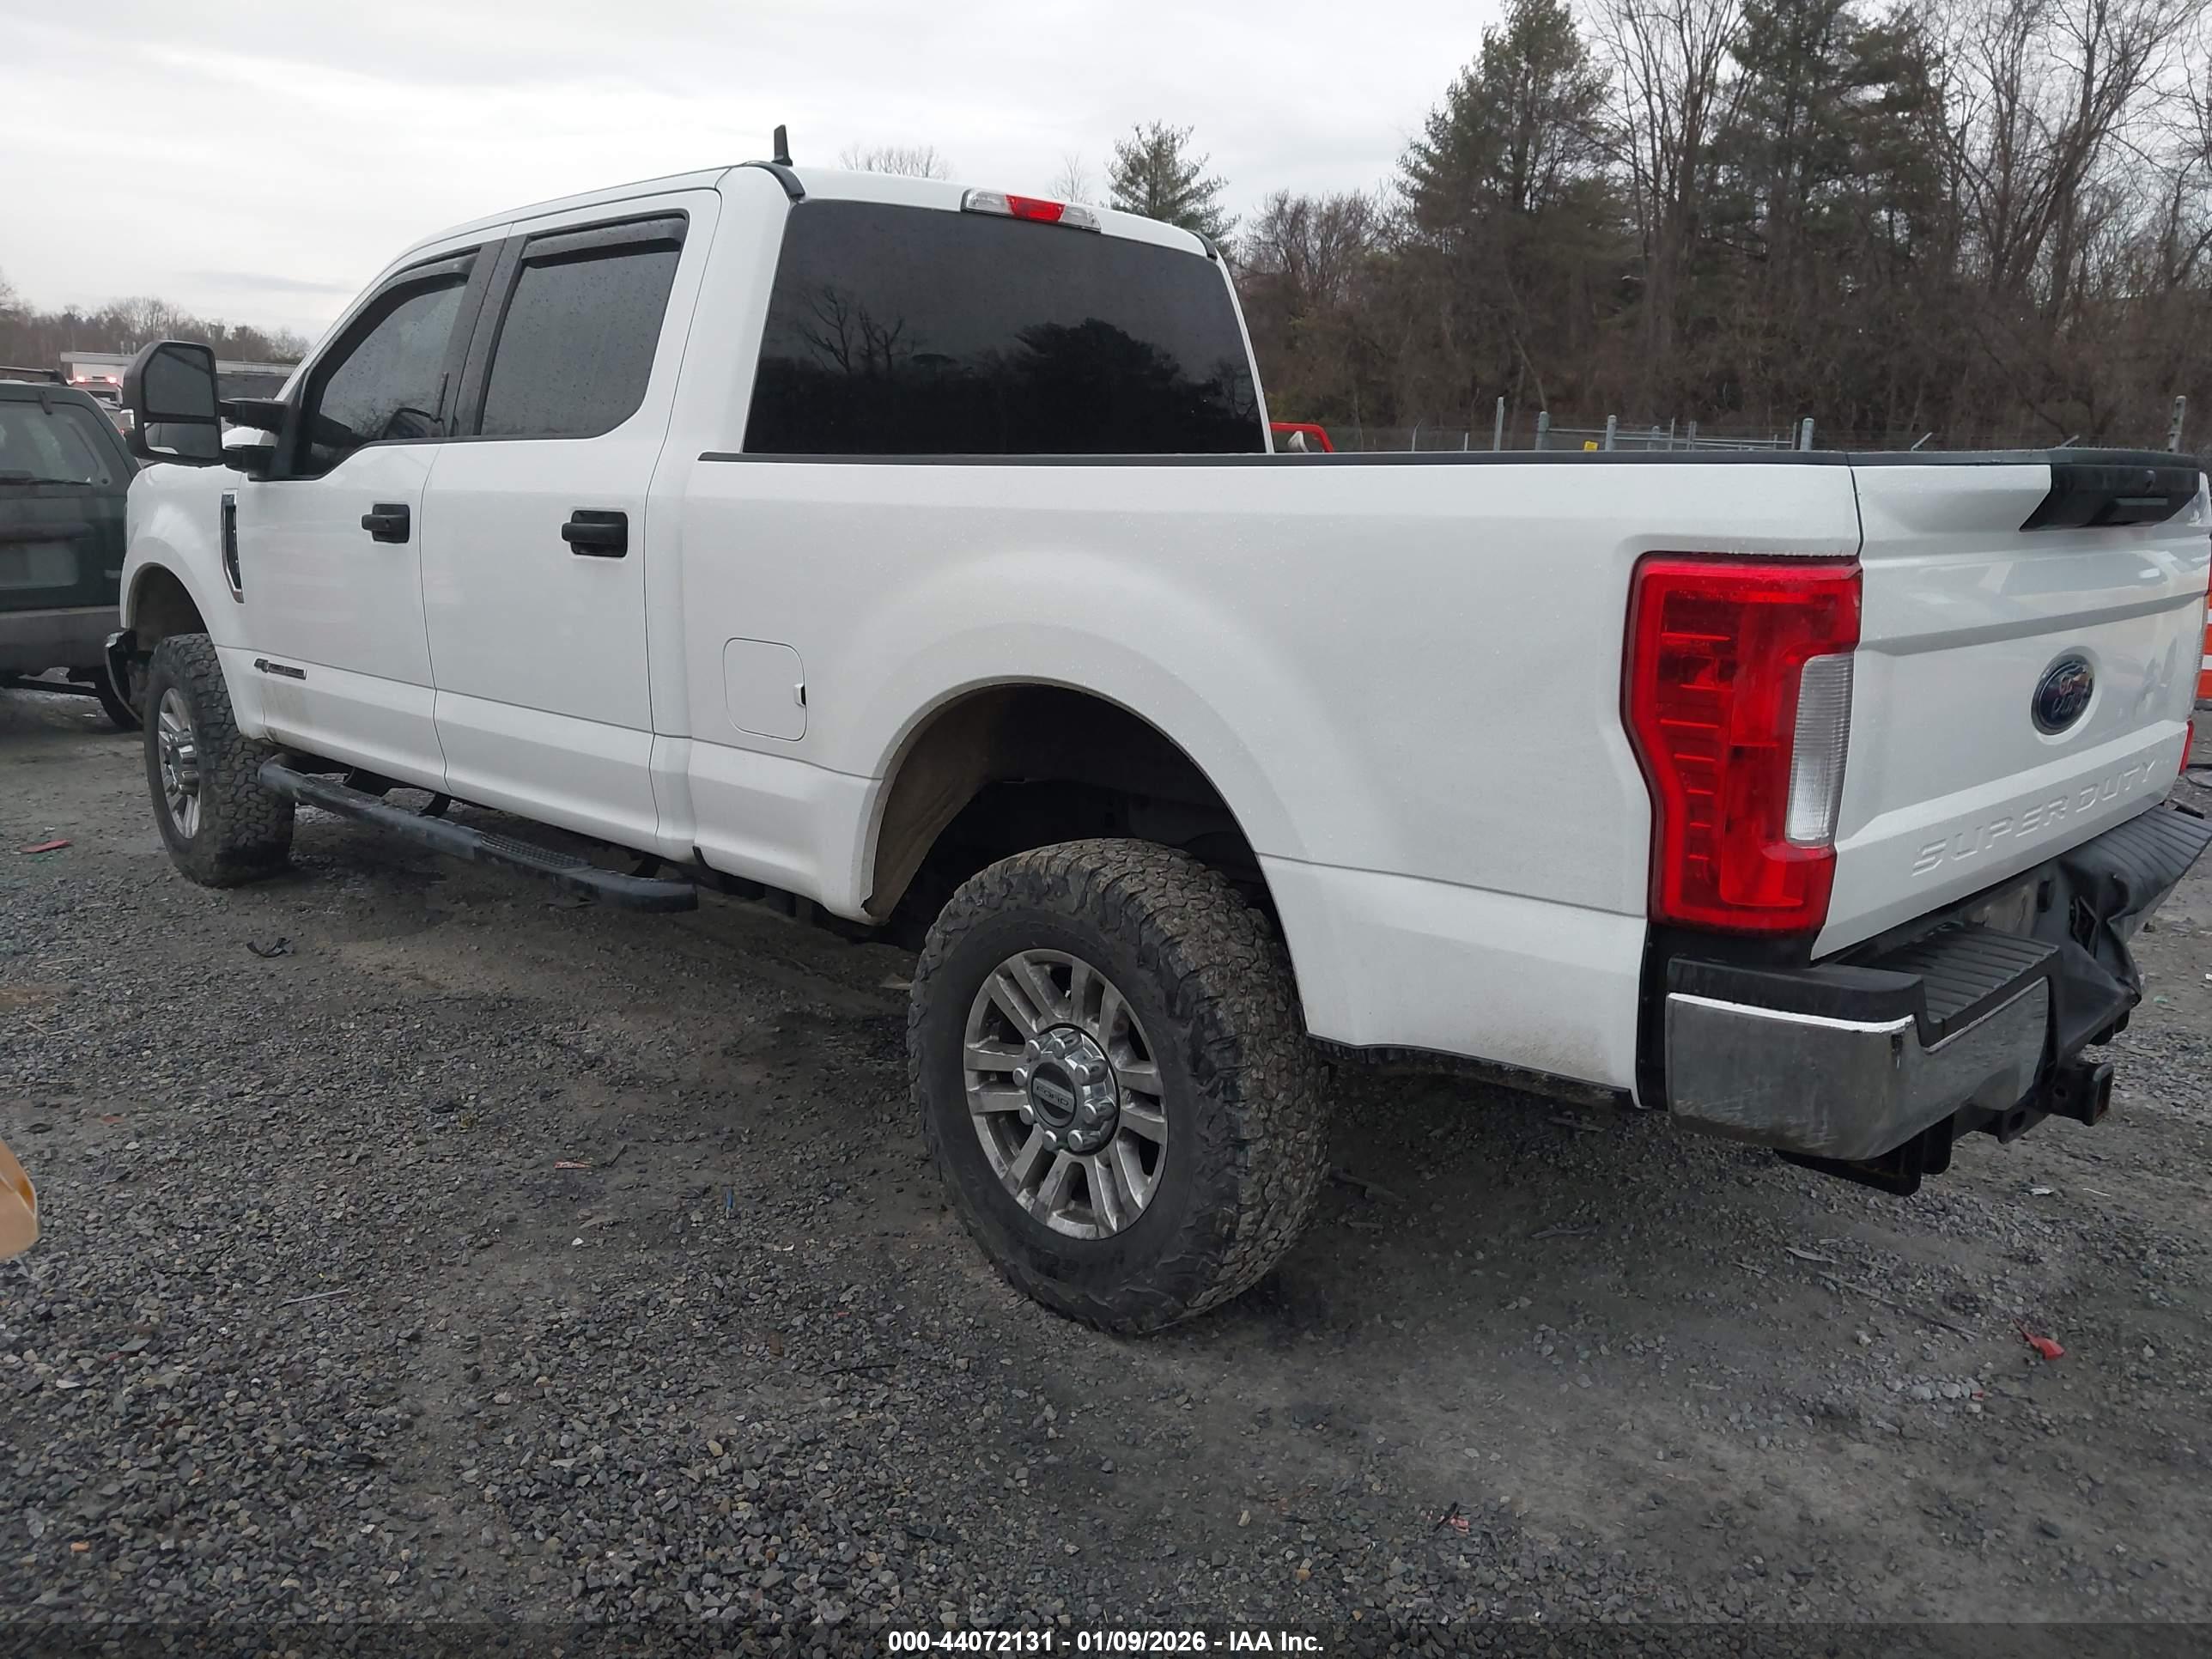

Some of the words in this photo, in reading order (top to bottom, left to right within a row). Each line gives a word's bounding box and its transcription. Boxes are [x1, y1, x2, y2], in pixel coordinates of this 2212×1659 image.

[1911, 795, 2069, 878] SUPER
[2075, 760, 2156, 812] DUTY
[1036, 1085, 1069, 1107] FORD
